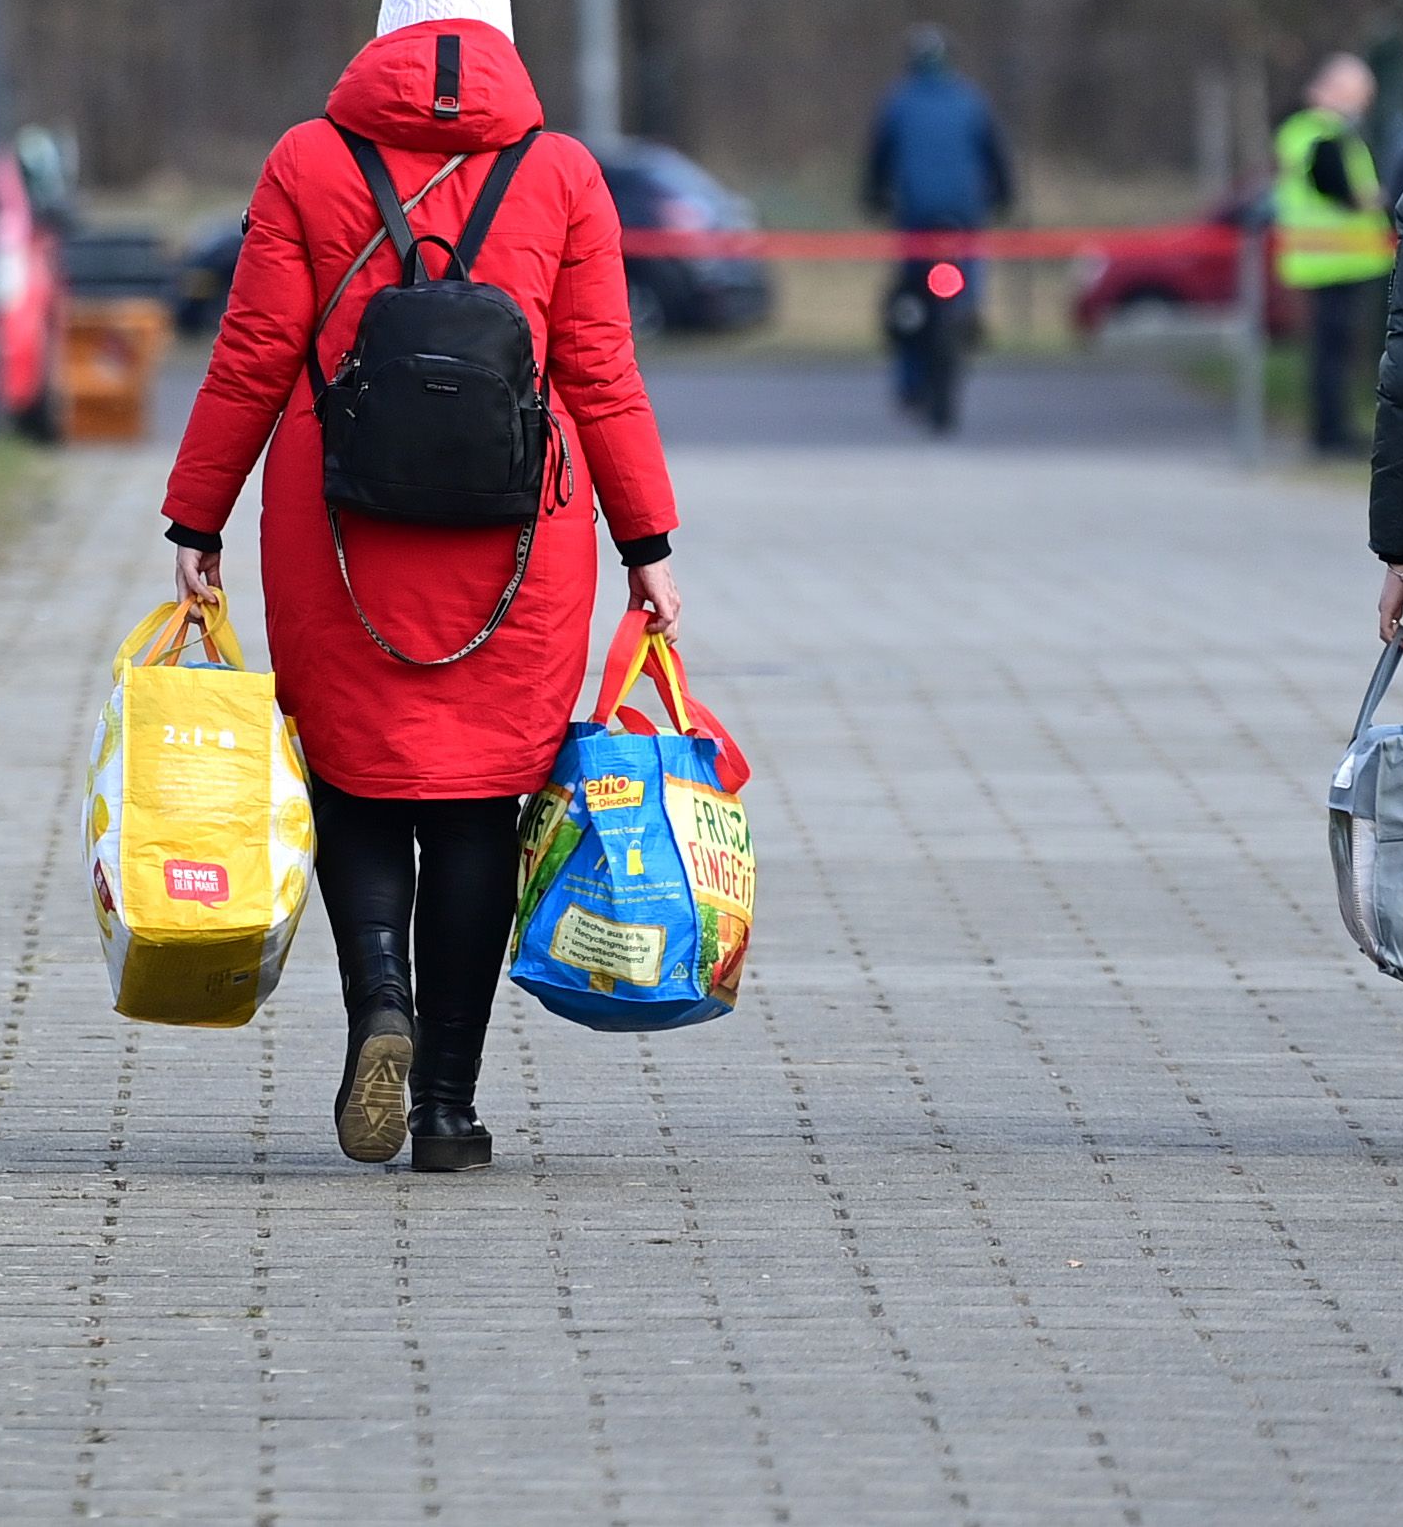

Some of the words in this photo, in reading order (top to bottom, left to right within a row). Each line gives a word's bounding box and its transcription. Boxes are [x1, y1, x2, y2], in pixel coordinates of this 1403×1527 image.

[172, 868, 219, 882] REWE
[173, 879, 193, 891] DEIN
[194, 880, 219, 892] MARKT
[574, 926, 651, 952] Recyclingmaterial
[577, 916, 605, 934] Tasche
[607, 929, 623, 939] aus
[571, 938, 645, 964] umweltschonend
